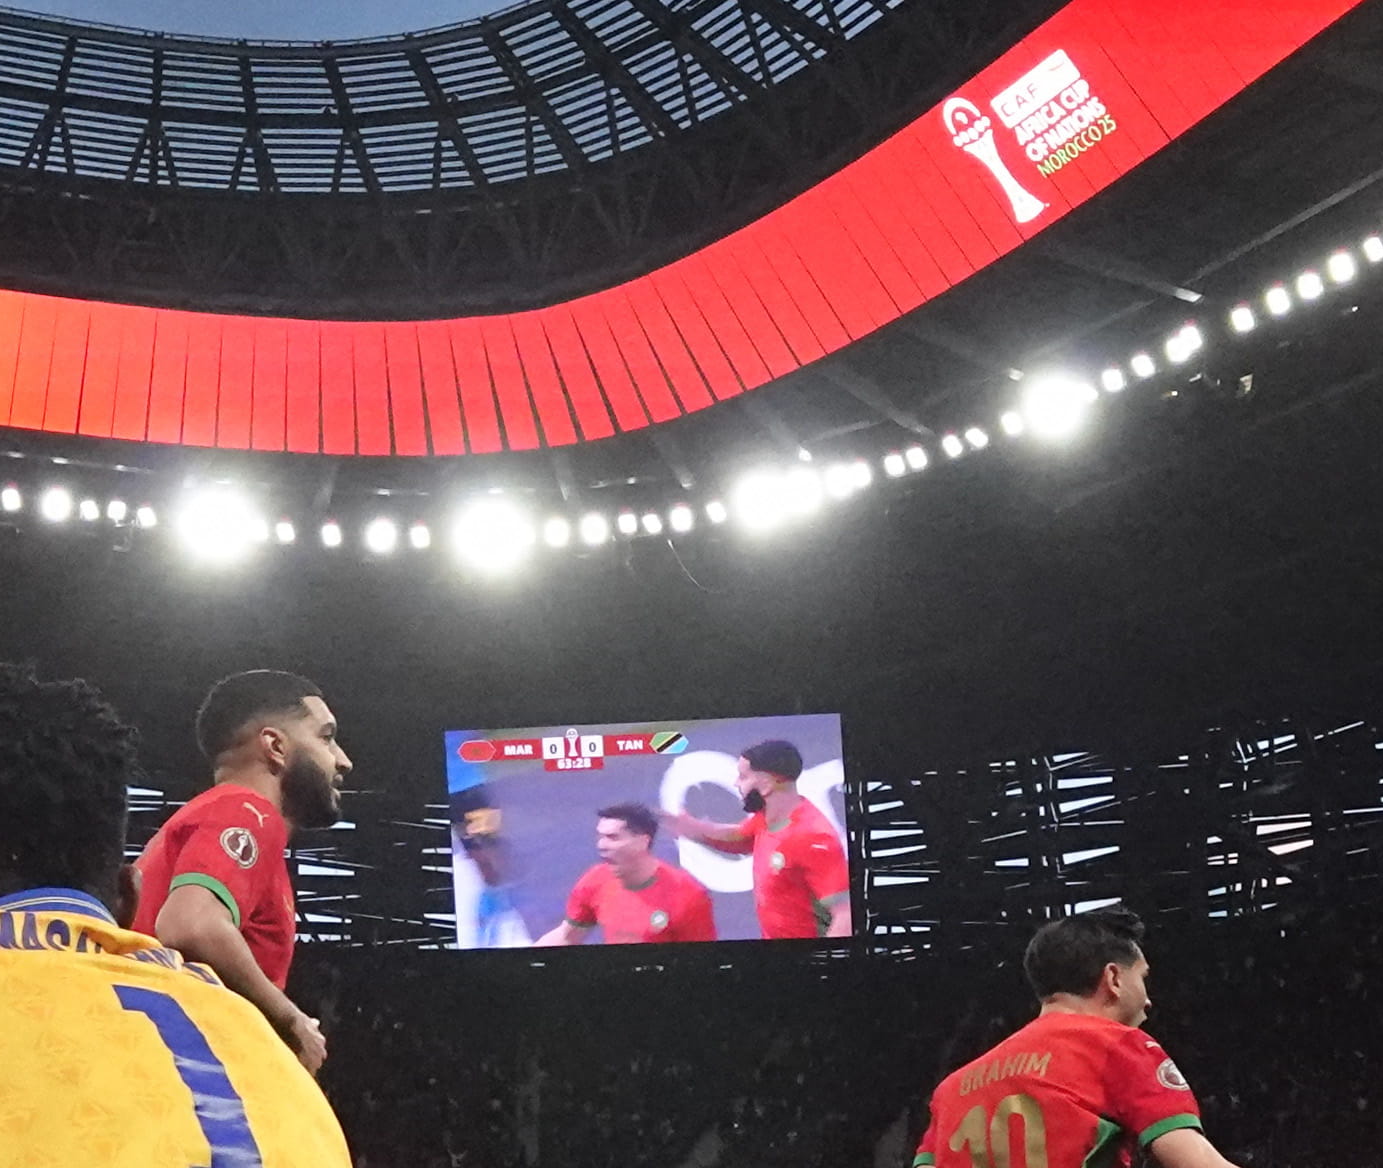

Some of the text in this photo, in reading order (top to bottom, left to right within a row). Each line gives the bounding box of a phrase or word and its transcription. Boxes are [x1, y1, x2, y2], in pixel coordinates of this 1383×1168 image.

[1015, 79, 1090, 146] AFRICA CUP
[1025, 96, 1107, 162] OF NATIONS
[1037, 114, 1117, 178] MOROCCO 25
[504, 740, 644, 756] MAR 0 0 TAN
